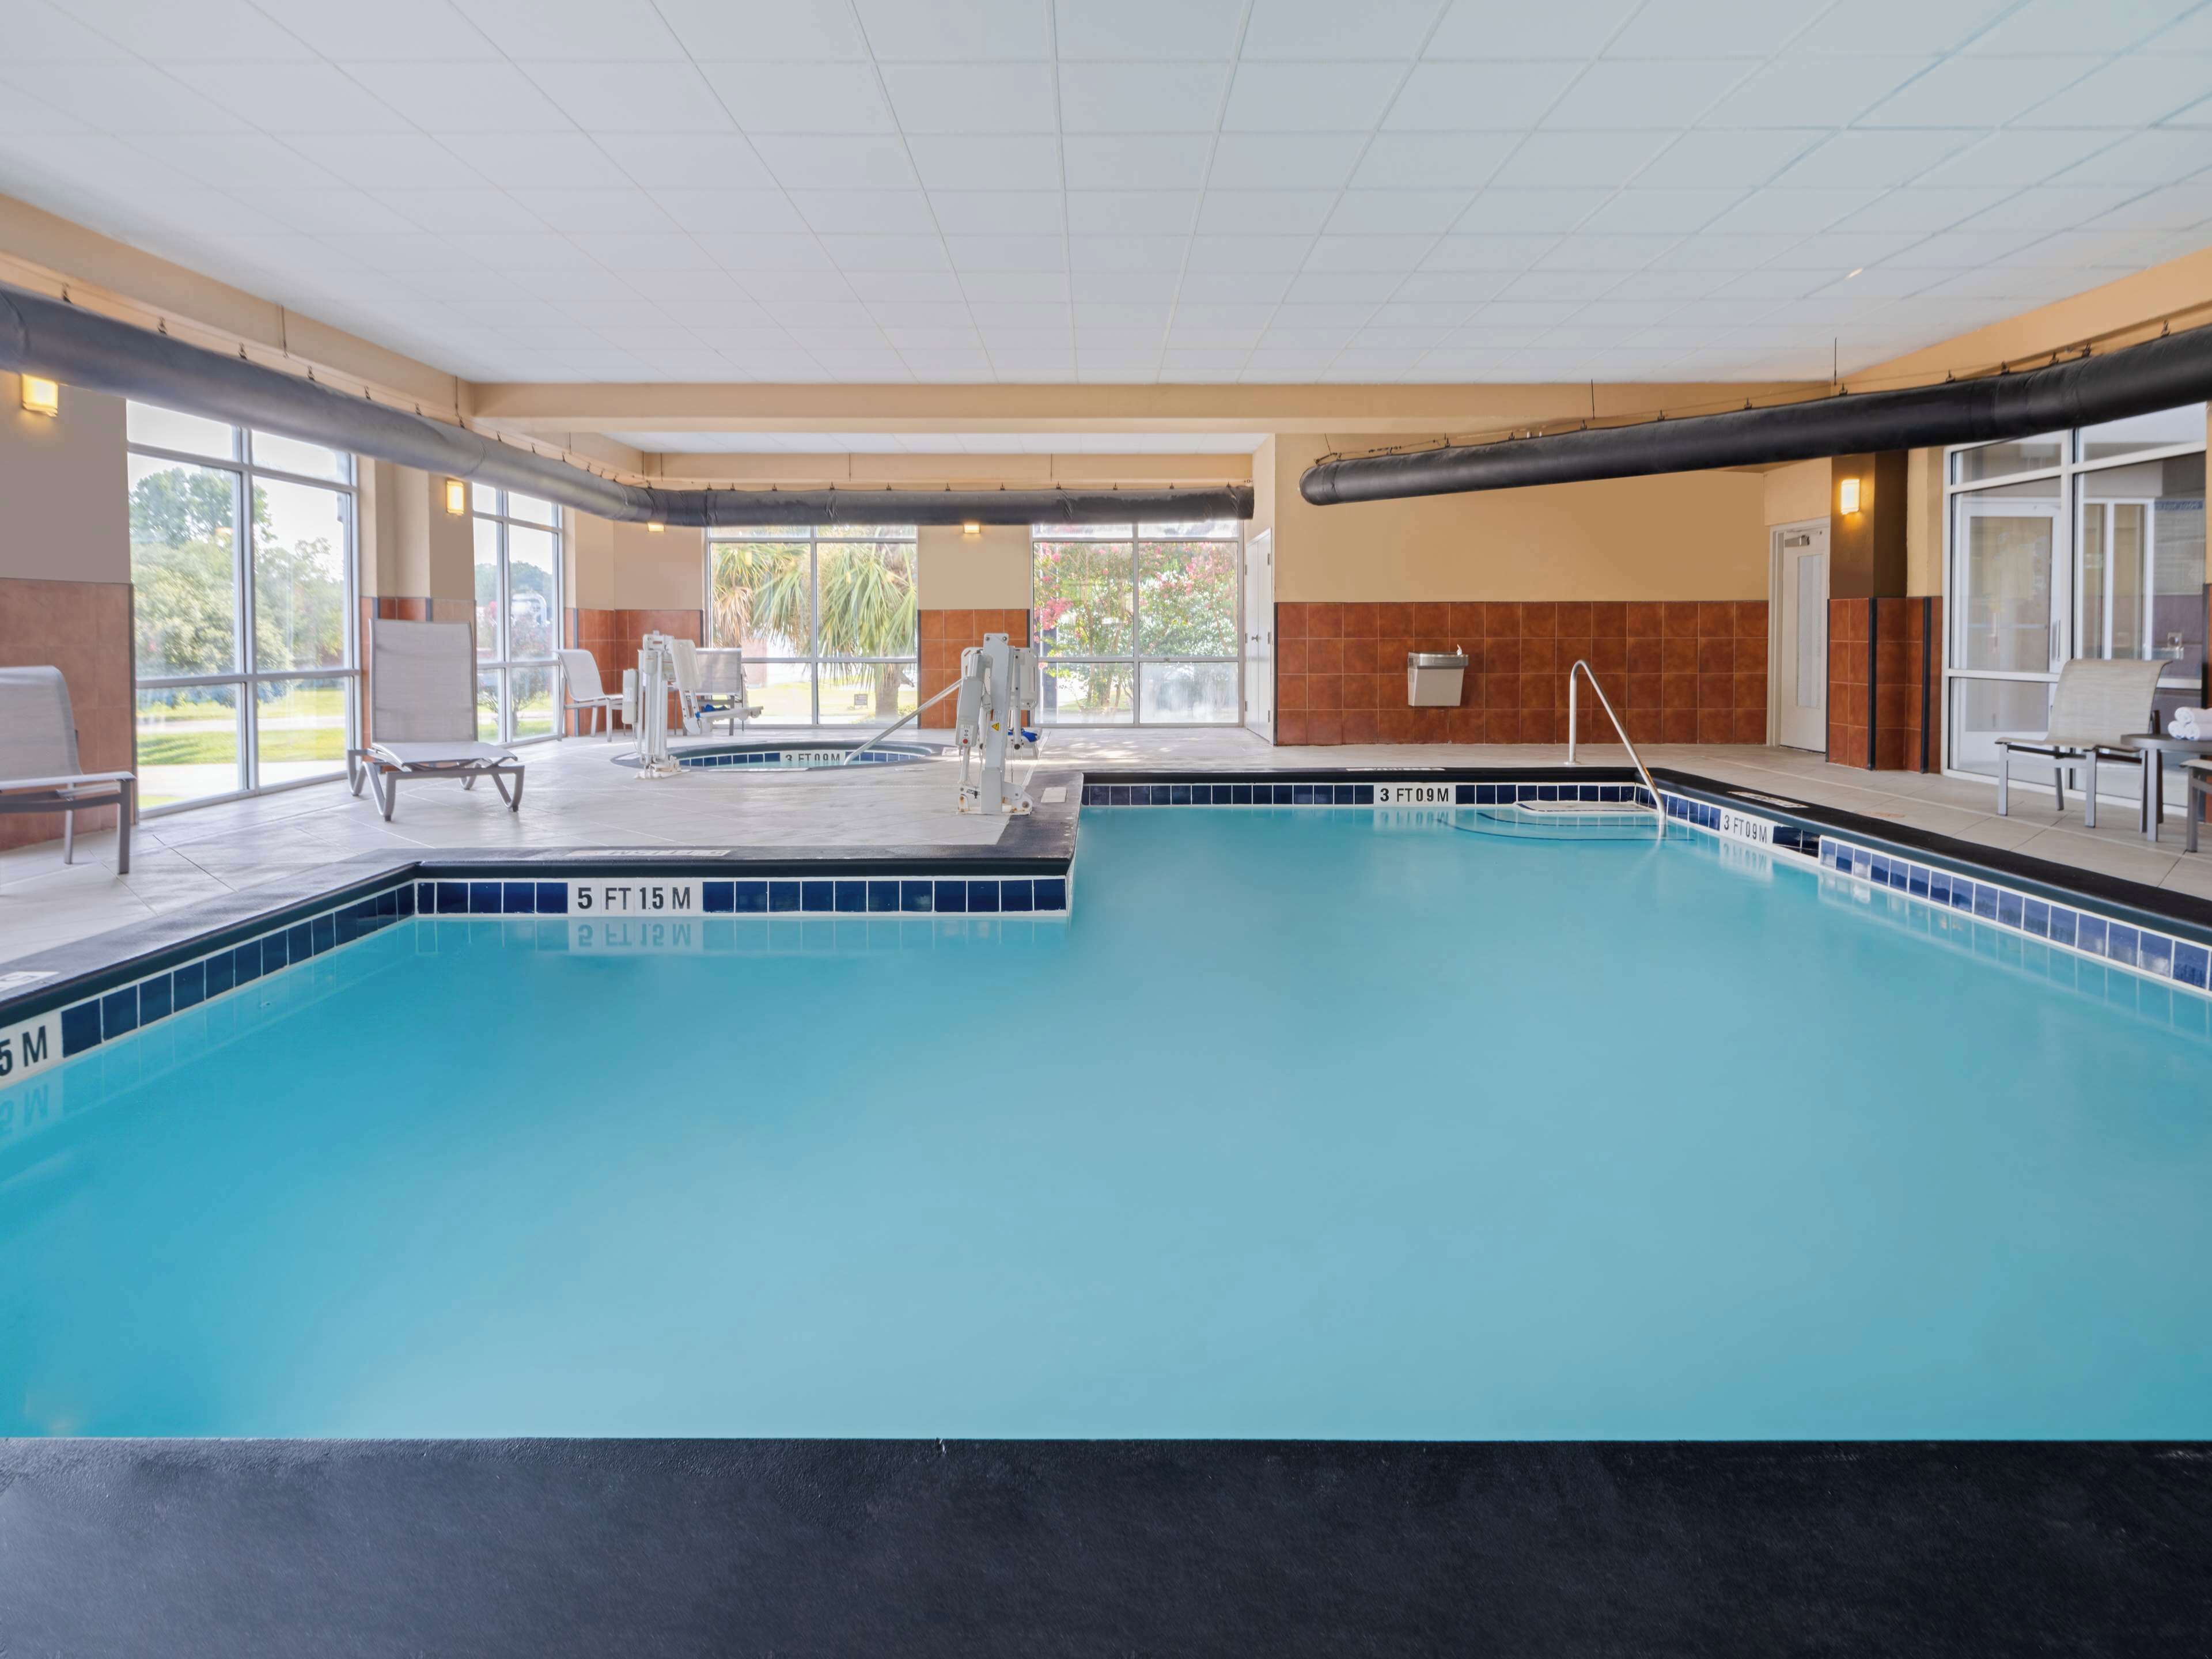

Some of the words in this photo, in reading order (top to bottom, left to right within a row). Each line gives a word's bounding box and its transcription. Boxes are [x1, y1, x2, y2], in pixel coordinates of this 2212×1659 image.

[1380, 788, 1389, 802] 3
[1397, 788, 1413, 802] FT
[1437, 788, 1449, 802] M
[1724, 815, 1730, 831] 3
[1733, 817, 1744, 836] FT
[1759, 824, 1767, 844] M
[578, 887, 593, 910] 5
[605, 887, 631, 910] FT
[672, 887, 691, 910] M
[22, 1025, 47, 1067] M
